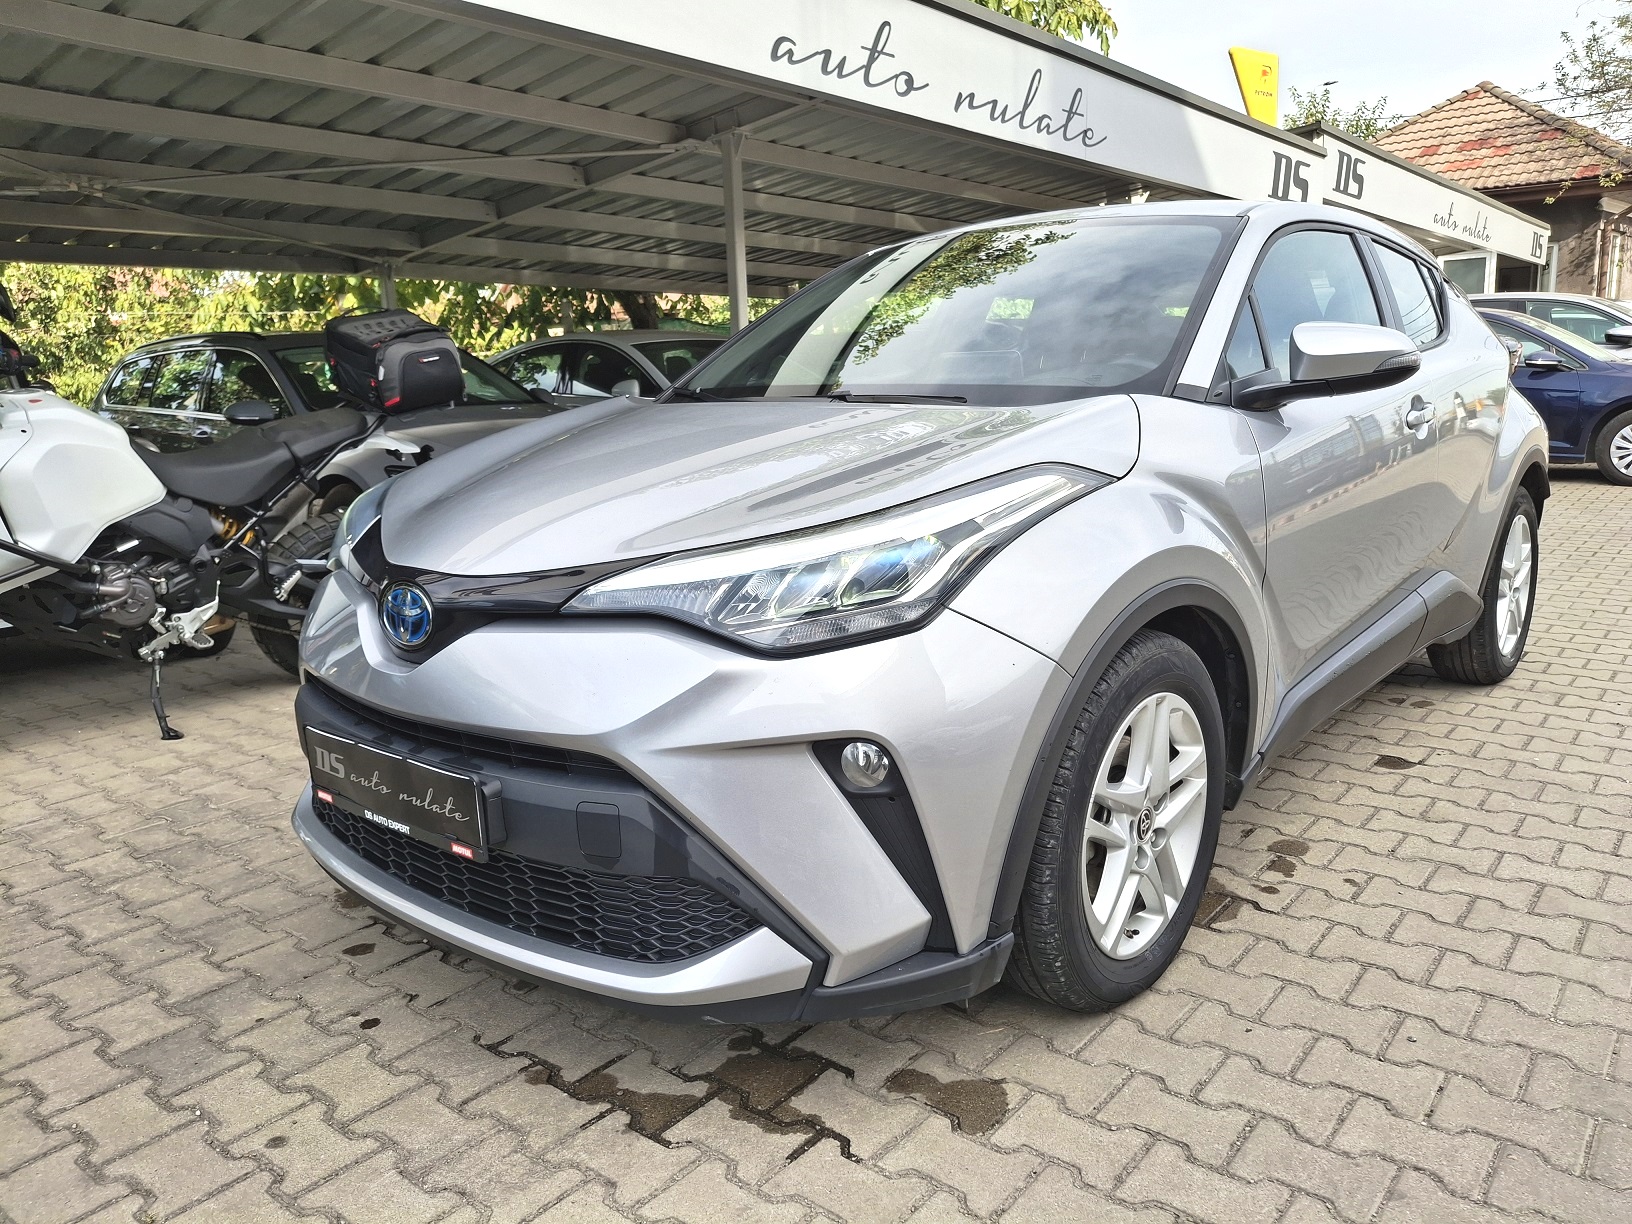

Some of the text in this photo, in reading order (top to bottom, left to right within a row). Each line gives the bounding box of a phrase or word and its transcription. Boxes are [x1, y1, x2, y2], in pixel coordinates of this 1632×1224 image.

[770, 20, 1108, 148] auto nulate
[1268, 150, 1311, 202] DS
[1332, 149, 1366, 200] DS
[1433, 201, 1459, 232] auto
[1530, 231, 1544, 259] DS
[314, 746, 345, 779] DS
[350, 770, 392, 794] auto
[373, 813, 389, 827] AUTO
[387, 819, 411, 835] EXPERT
[452, 845, 472, 857] MOTUL
